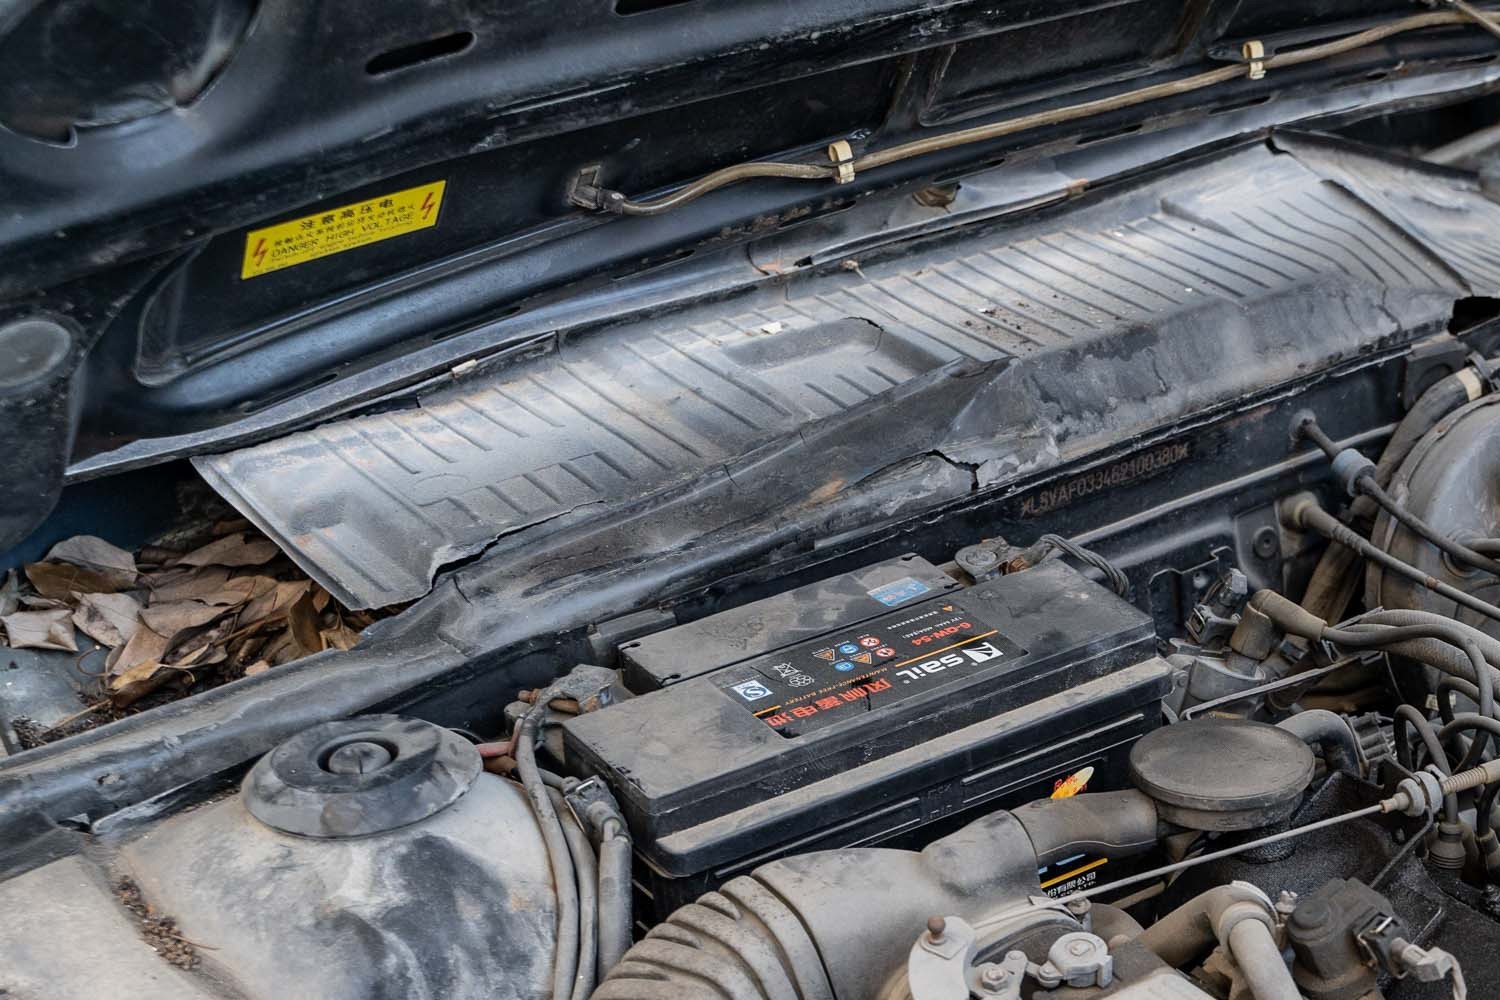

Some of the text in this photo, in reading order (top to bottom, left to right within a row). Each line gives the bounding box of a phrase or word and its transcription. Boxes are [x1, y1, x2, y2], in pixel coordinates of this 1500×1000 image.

[300, 198, 394, 231] 注意高压电
[271, 238, 318, 258] DANGER
[326, 227, 355, 243] HIGH
[764, 677, 893, 727] 风帆蓄电池
